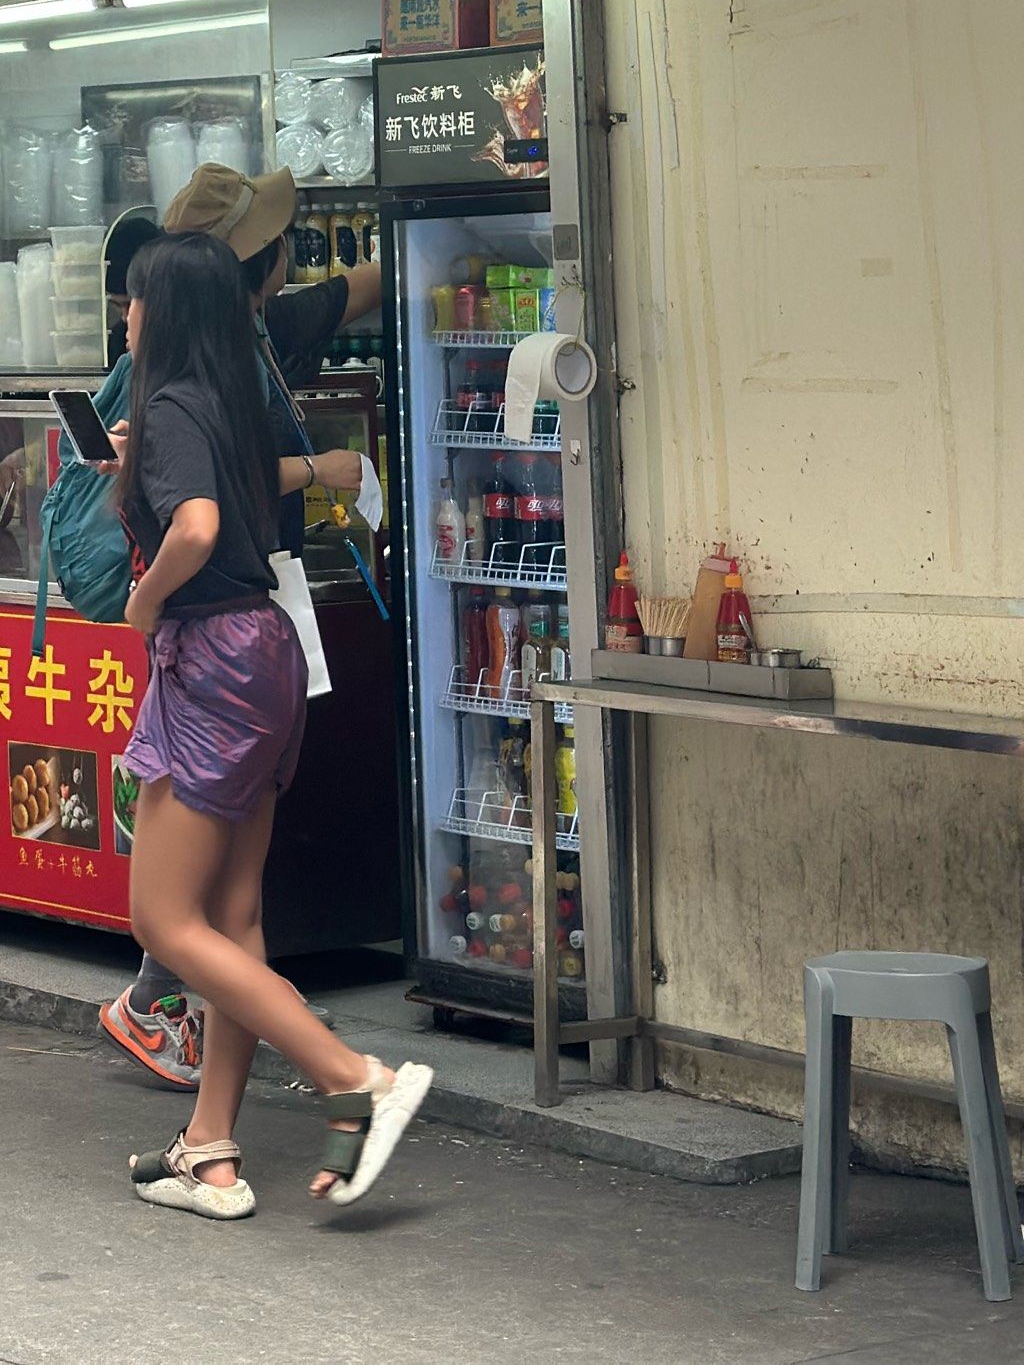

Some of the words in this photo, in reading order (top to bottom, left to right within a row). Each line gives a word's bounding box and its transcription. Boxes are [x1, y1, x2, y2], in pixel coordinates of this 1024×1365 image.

[396, 90, 428, 105] Frestec
[430, 84, 462, 102] 新飞
[385, 110, 476, 142] 新飞饮料柜
[408, 144, 431, 154] FREEZE
[432, 143, 452, 153] DRINK
